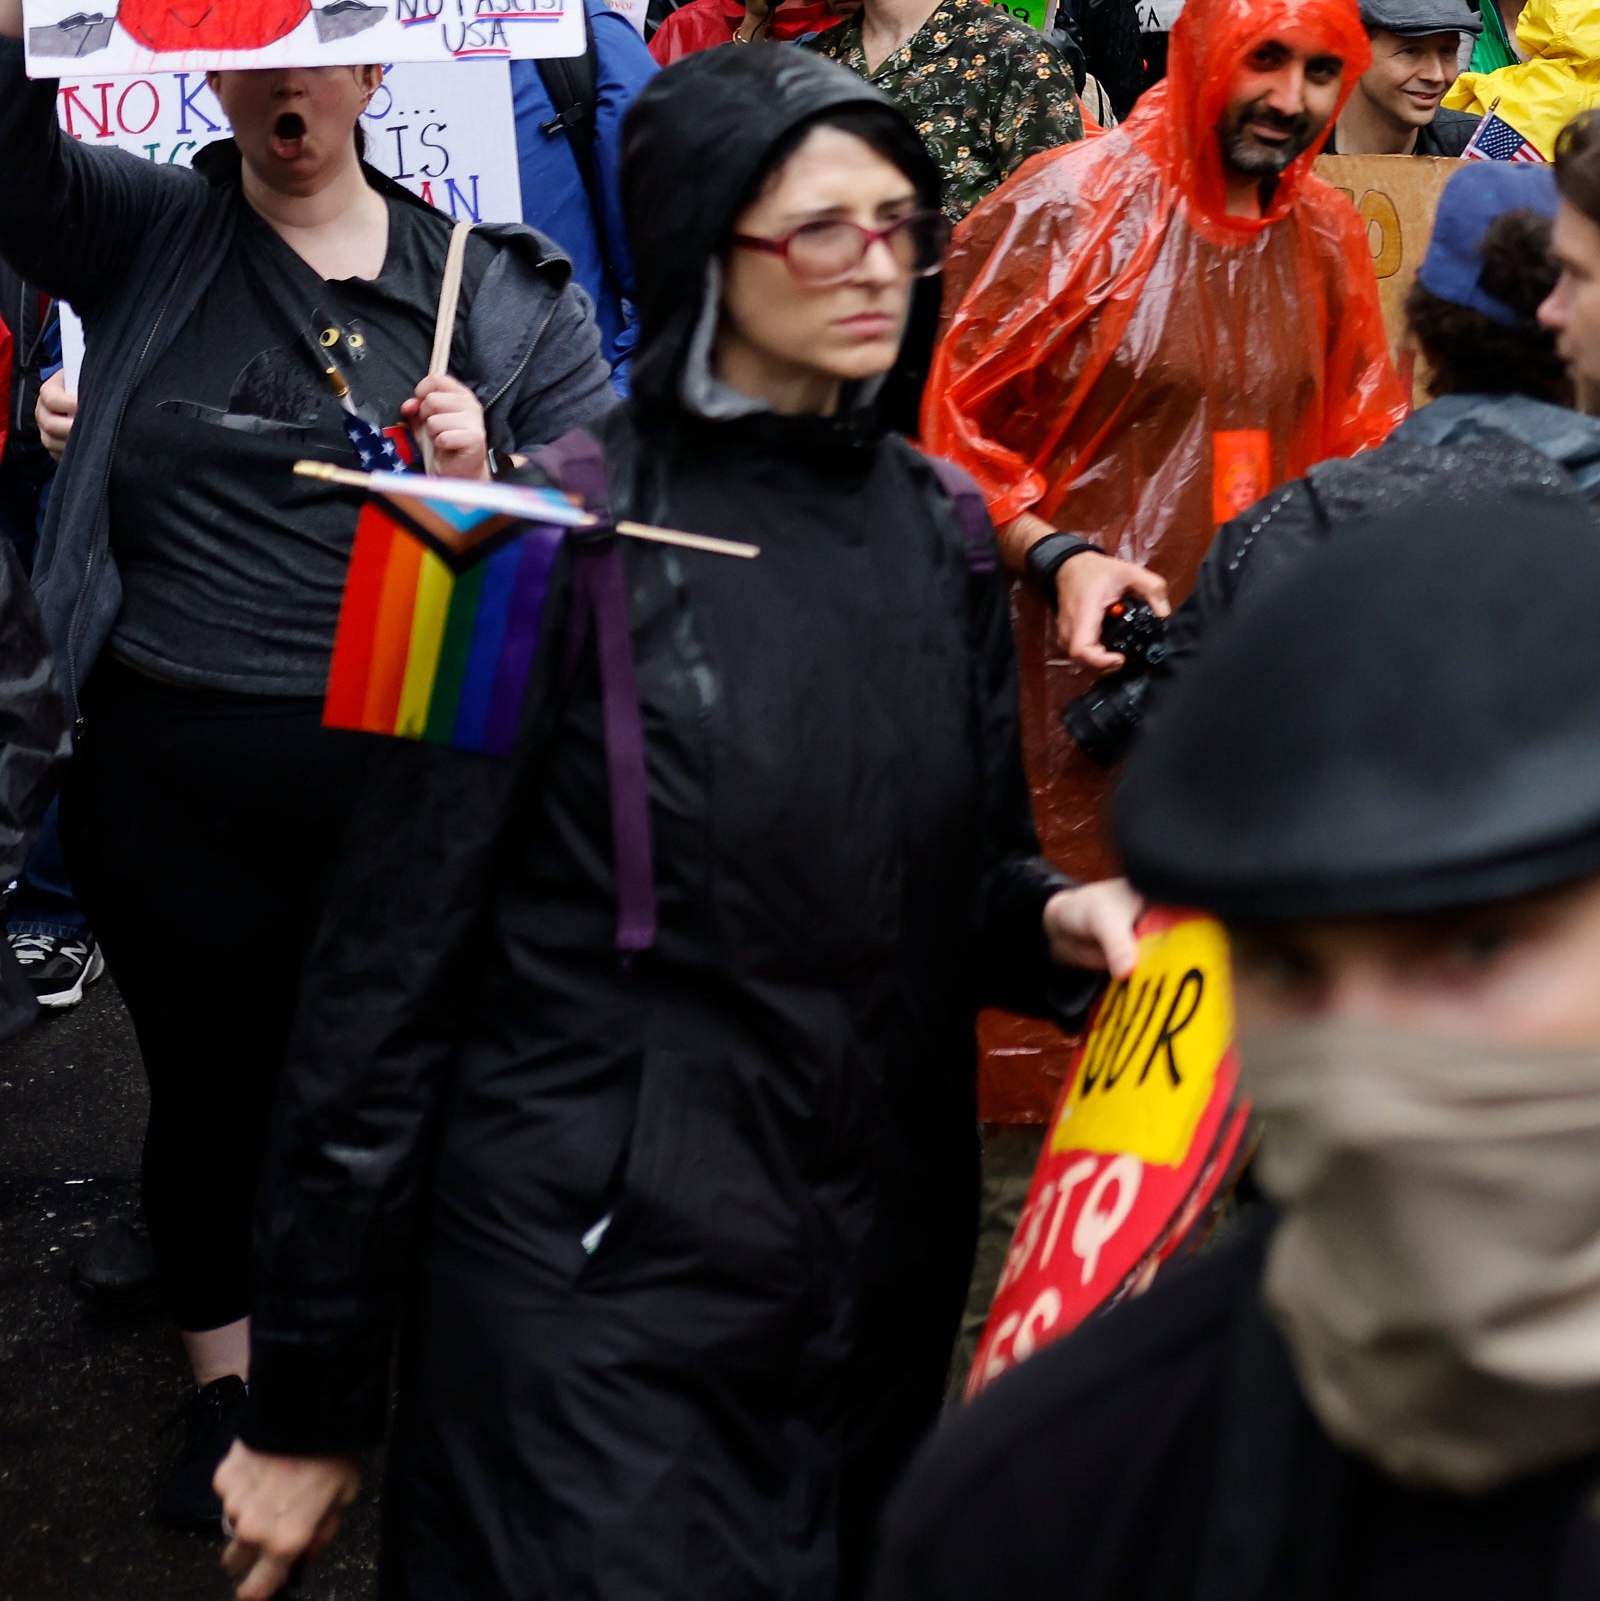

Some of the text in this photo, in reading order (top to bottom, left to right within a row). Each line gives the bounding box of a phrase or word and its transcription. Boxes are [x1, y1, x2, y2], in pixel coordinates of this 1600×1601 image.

[442, 21, 508, 53] USA
[61, 80, 160, 139] NO
[387, 123, 450, 181] IS
